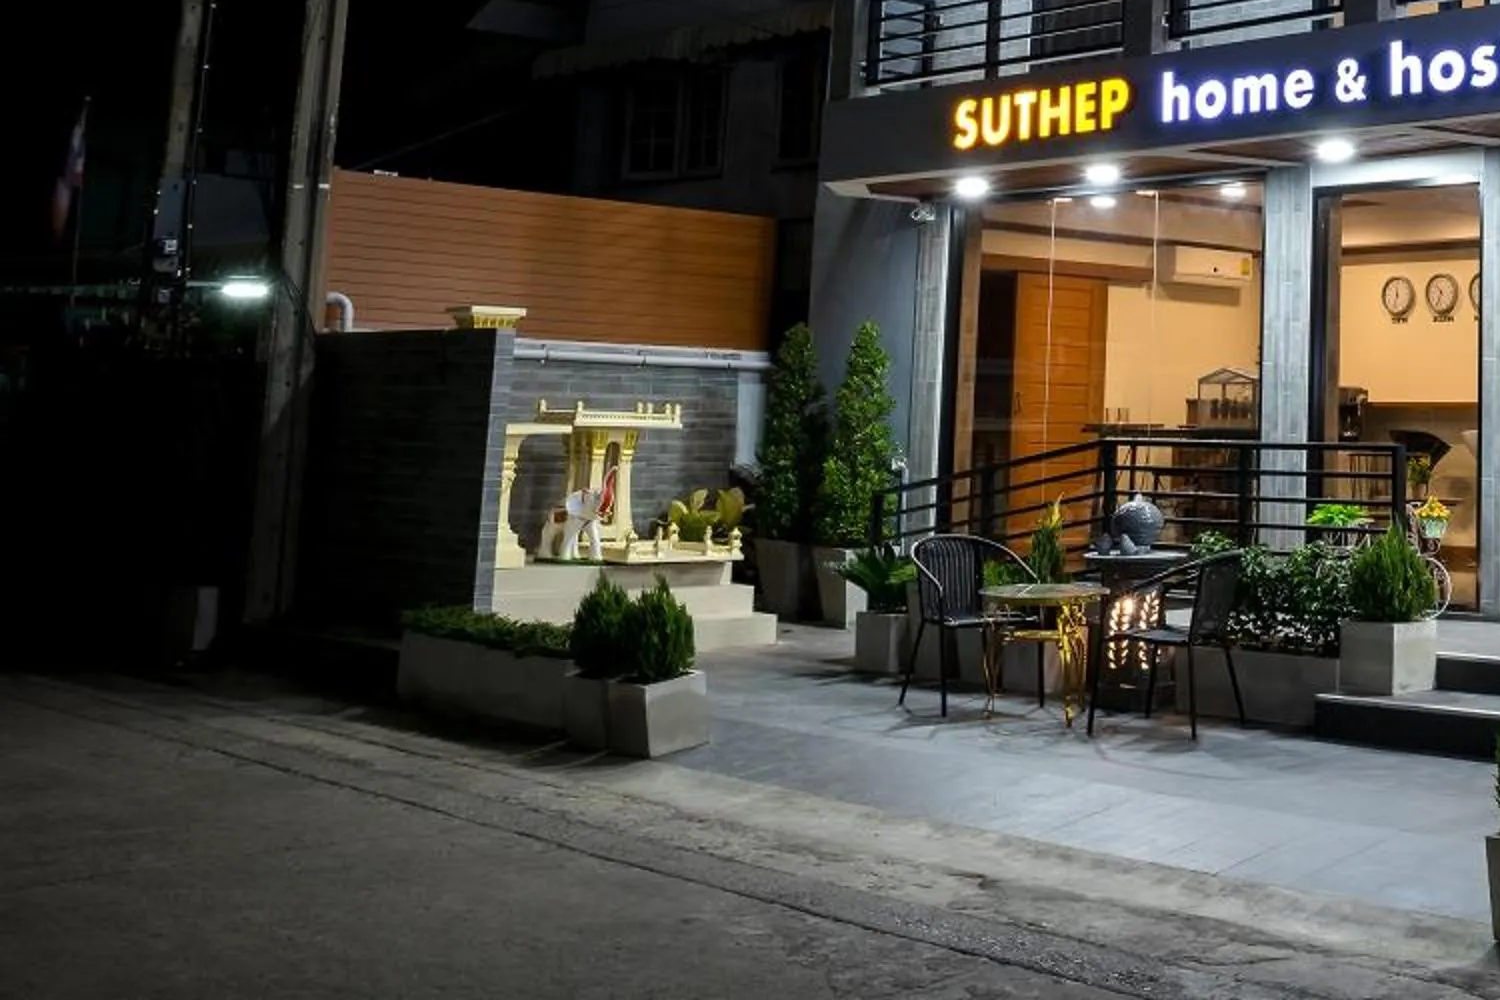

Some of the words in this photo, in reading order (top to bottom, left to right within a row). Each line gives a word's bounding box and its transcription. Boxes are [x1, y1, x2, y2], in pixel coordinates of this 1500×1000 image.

[953, 78, 1130, 150] SUTHEP
[1161, 69, 1314, 123] home
[1335, 57, 1367, 103] &
